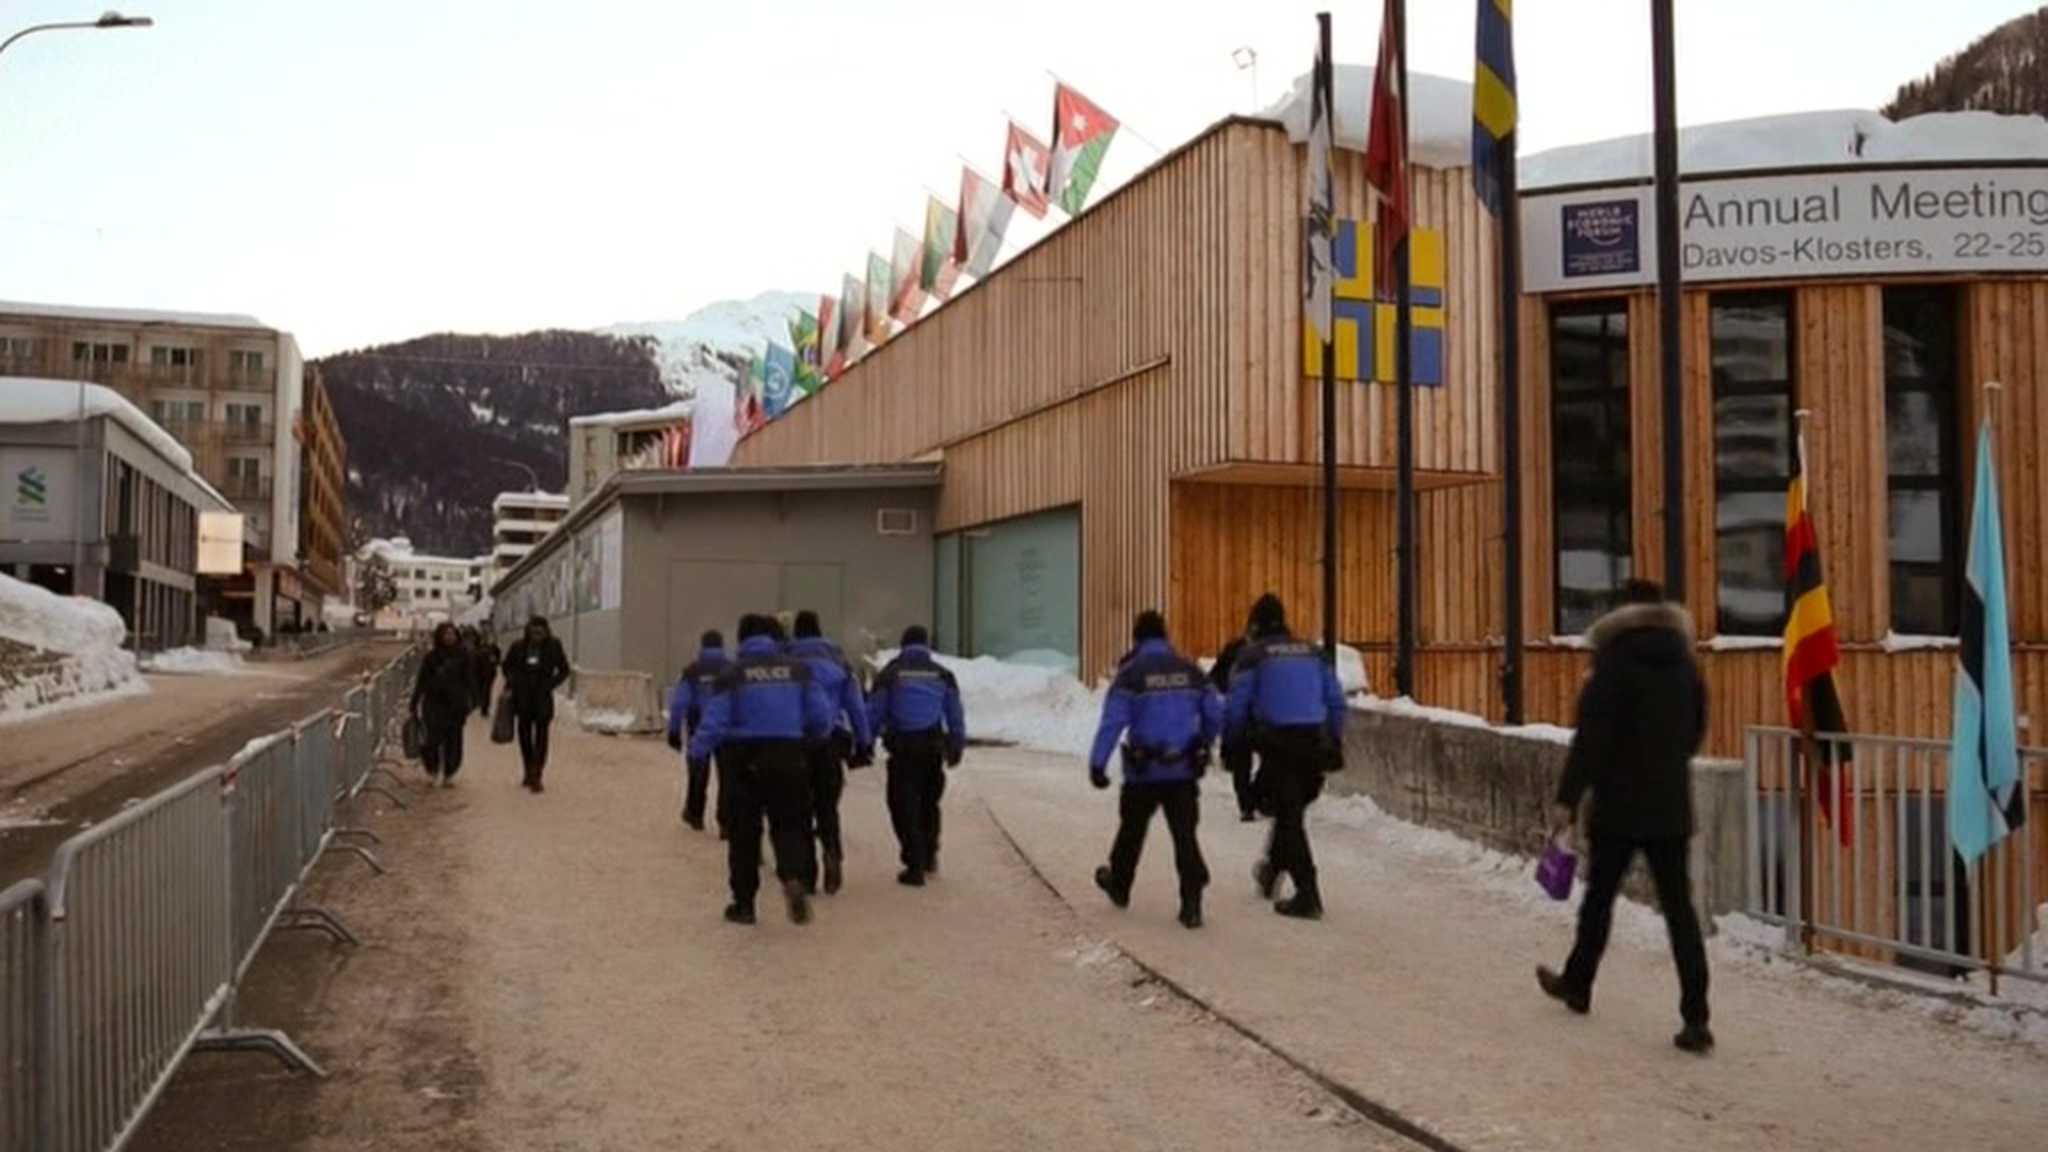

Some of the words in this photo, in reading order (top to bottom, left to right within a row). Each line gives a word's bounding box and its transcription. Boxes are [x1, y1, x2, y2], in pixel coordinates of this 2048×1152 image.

[1684, 185, 1840, 230] Annual
[1871, 179, 2048, 225] Meeting
[1683, 236, 1932, 269] Davos-Klosters,
[1953, 231, 2045, 258] 22-25
[744, 665, 791, 681] POLICE
[1145, 672, 1190, 688] POLICE
